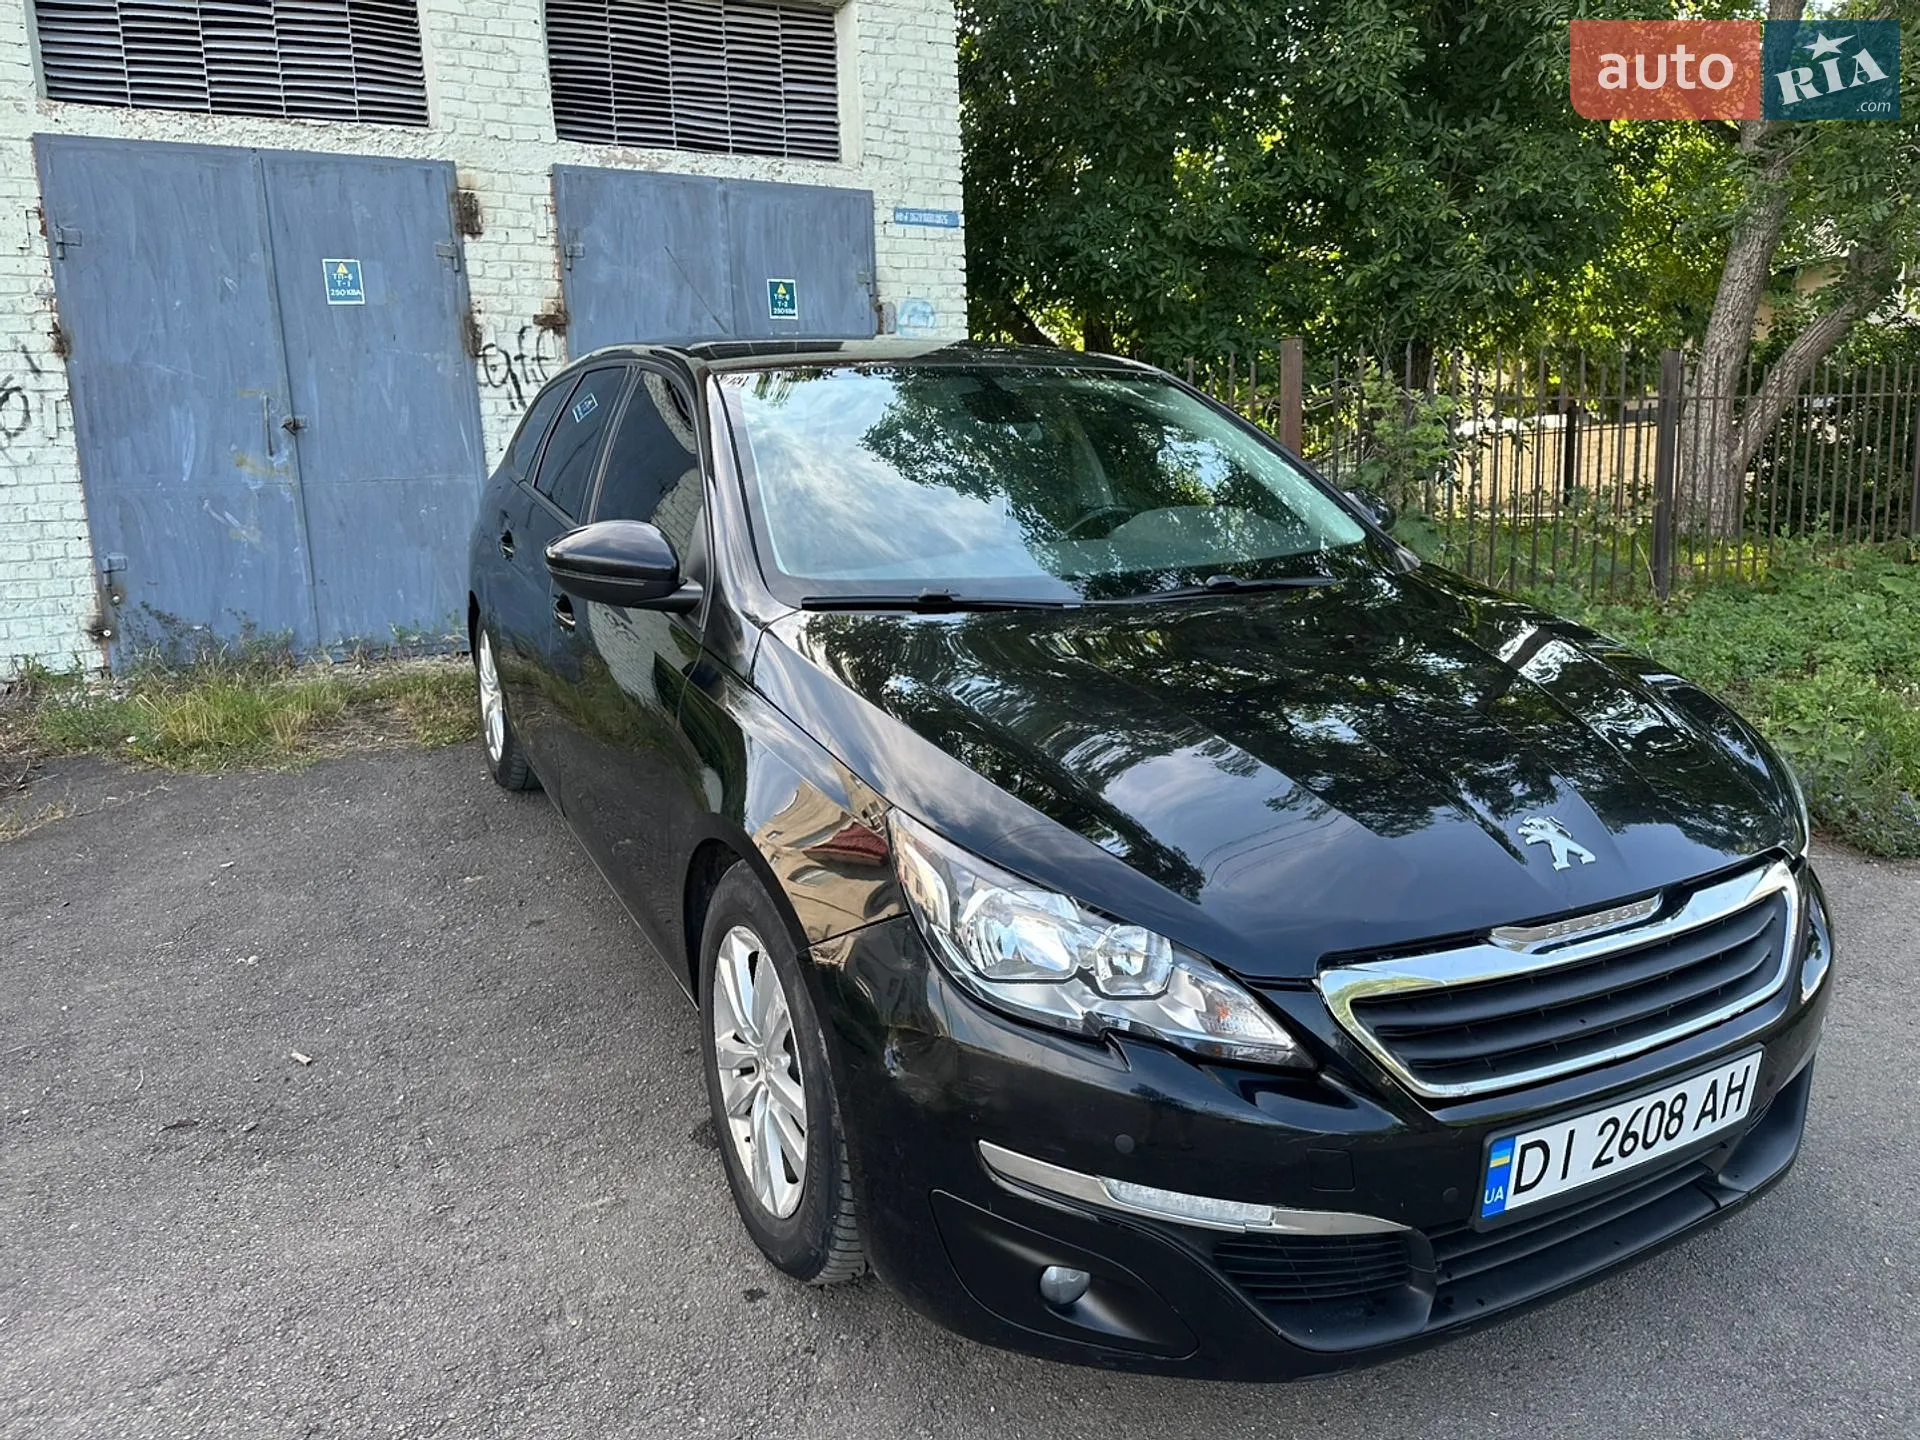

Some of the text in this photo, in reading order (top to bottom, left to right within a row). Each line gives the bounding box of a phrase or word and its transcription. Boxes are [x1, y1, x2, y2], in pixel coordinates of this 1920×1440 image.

[1513, 1065, 1750, 1196] DI 2608 AH
[1484, 1186, 1504, 1205] UA
